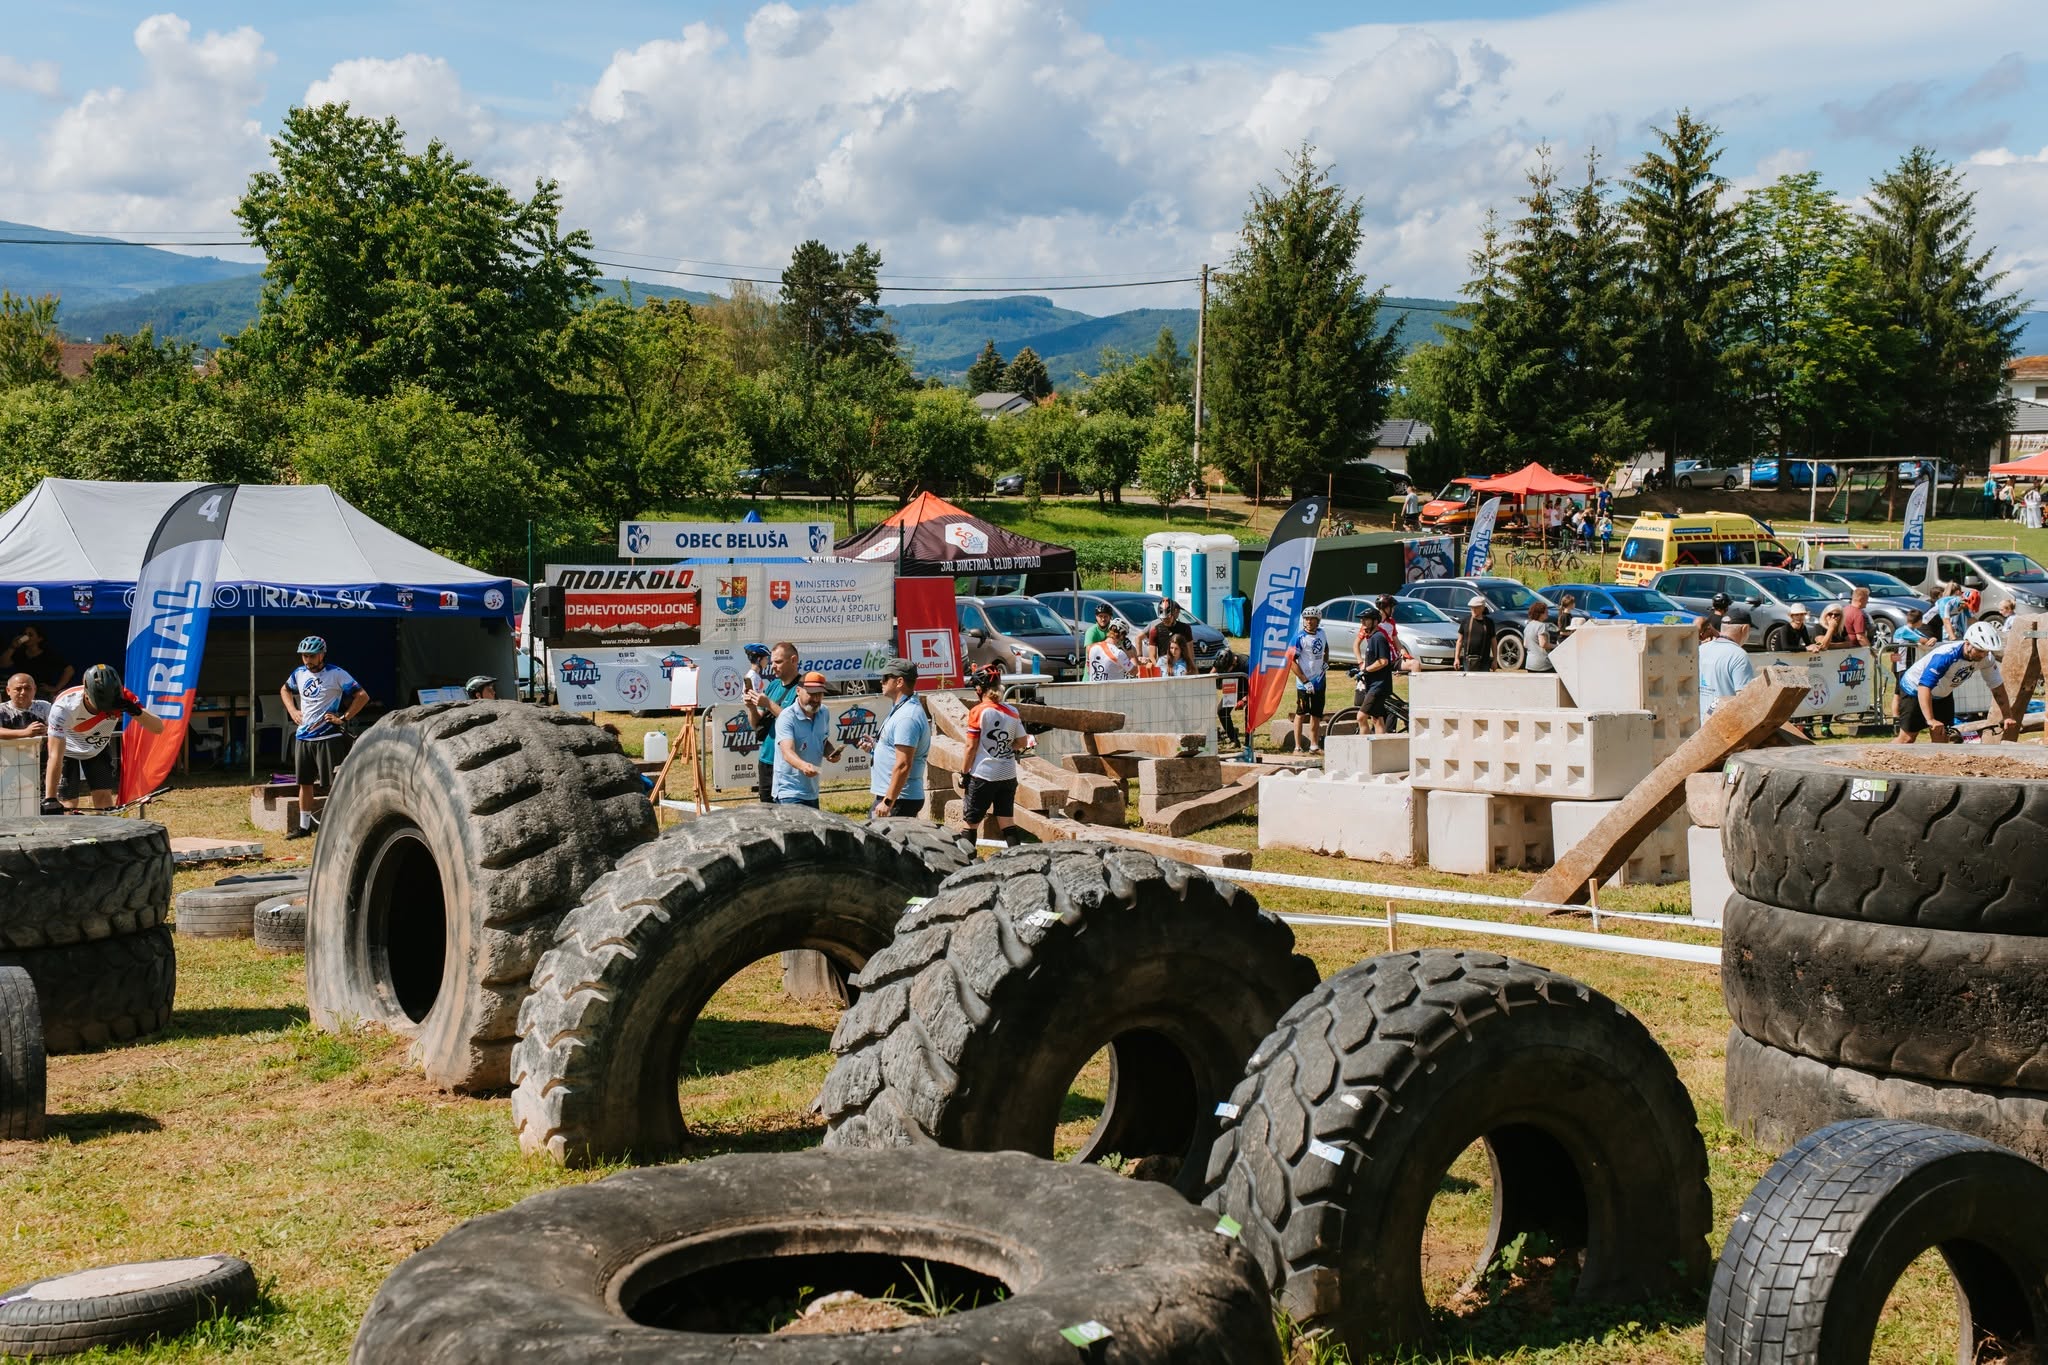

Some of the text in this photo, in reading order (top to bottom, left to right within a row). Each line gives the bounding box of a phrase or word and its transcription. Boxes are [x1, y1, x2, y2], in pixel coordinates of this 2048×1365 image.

[198, 494, 222, 522] 4
[1301, 503, 1319, 525] 3
[675, 530, 789, 549] OBEC BELUŠA
[1909, 515, 1924, 550] RIAL
[1418, 542, 1442, 555] TRIAL
[956, 558, 993, 572] BIKETRIAL
[993, 557, 1013, 571] CLUB
[1013, 555, 1041, 569] POPRAD
[795, 579, 857, 589] MINISTERSTVO
[795, 593, 865, 604] ŠKOLSTVA, VEDY,
[795, 602, 838, 614] VÝSKUMU
[849, 602, 881, 613] ŠPORTU
[794, 613, 888, 625] SLOVENSKEJ REPUBLIKY
[1259, 566, 1301, 674] TRIAL
[601, 637, 650, 645] www.mojekolo.sk
[145, 579, 202, 721] TRIAL
[863, 650, 887, 671] life
[915, 660, 950, 670] Kaufland
[560, 668, 601, 683] TRIAL
[1838, 669, 1866, 684] TRIAL
[302, 677, 323, 698] CTVZ
[722, 730, 764, 748] TRIA
[836, 723, 878, 741] TRIAL
